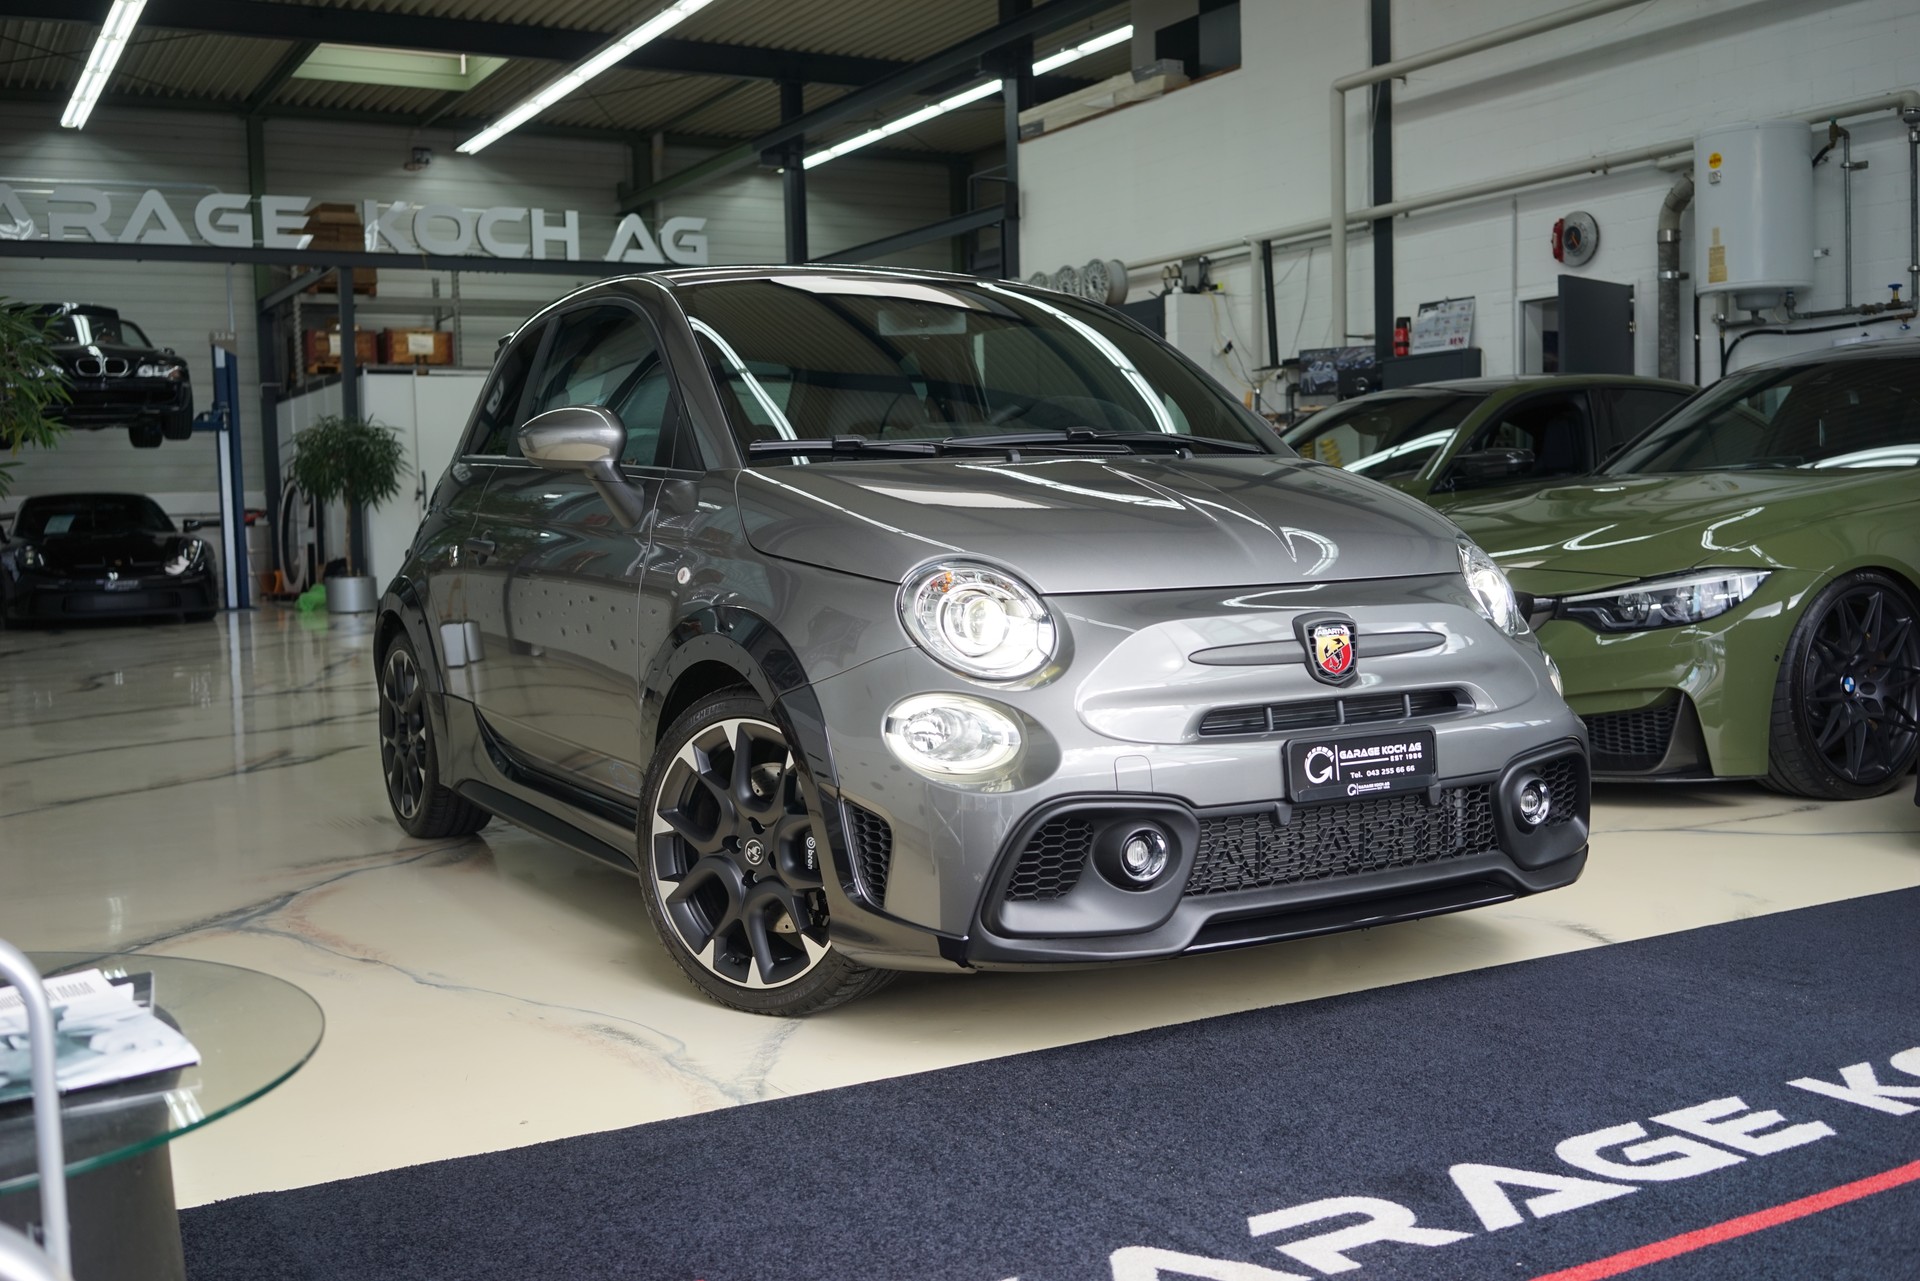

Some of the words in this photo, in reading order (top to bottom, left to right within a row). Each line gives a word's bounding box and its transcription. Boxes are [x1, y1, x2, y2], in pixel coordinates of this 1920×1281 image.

[0, 183, 313, 250] ARAGE
[364, 200, 579, 260] KOCH
[603, 213, 709, 265] AG
[1339, 746, 1380, 760] GARAGE
[1381, 743, 1406, 755] KOCH
[1408, 742, 1422, 751] AG
[1350, 771, 1363, 779] Tel.
[1366, 769, 1380, 777] 043
[1396, 766, 1405, 774] 66
[1001, 1096, 1837, 1281] ARAGE
[1786, 1046, 1920, 1116] K
